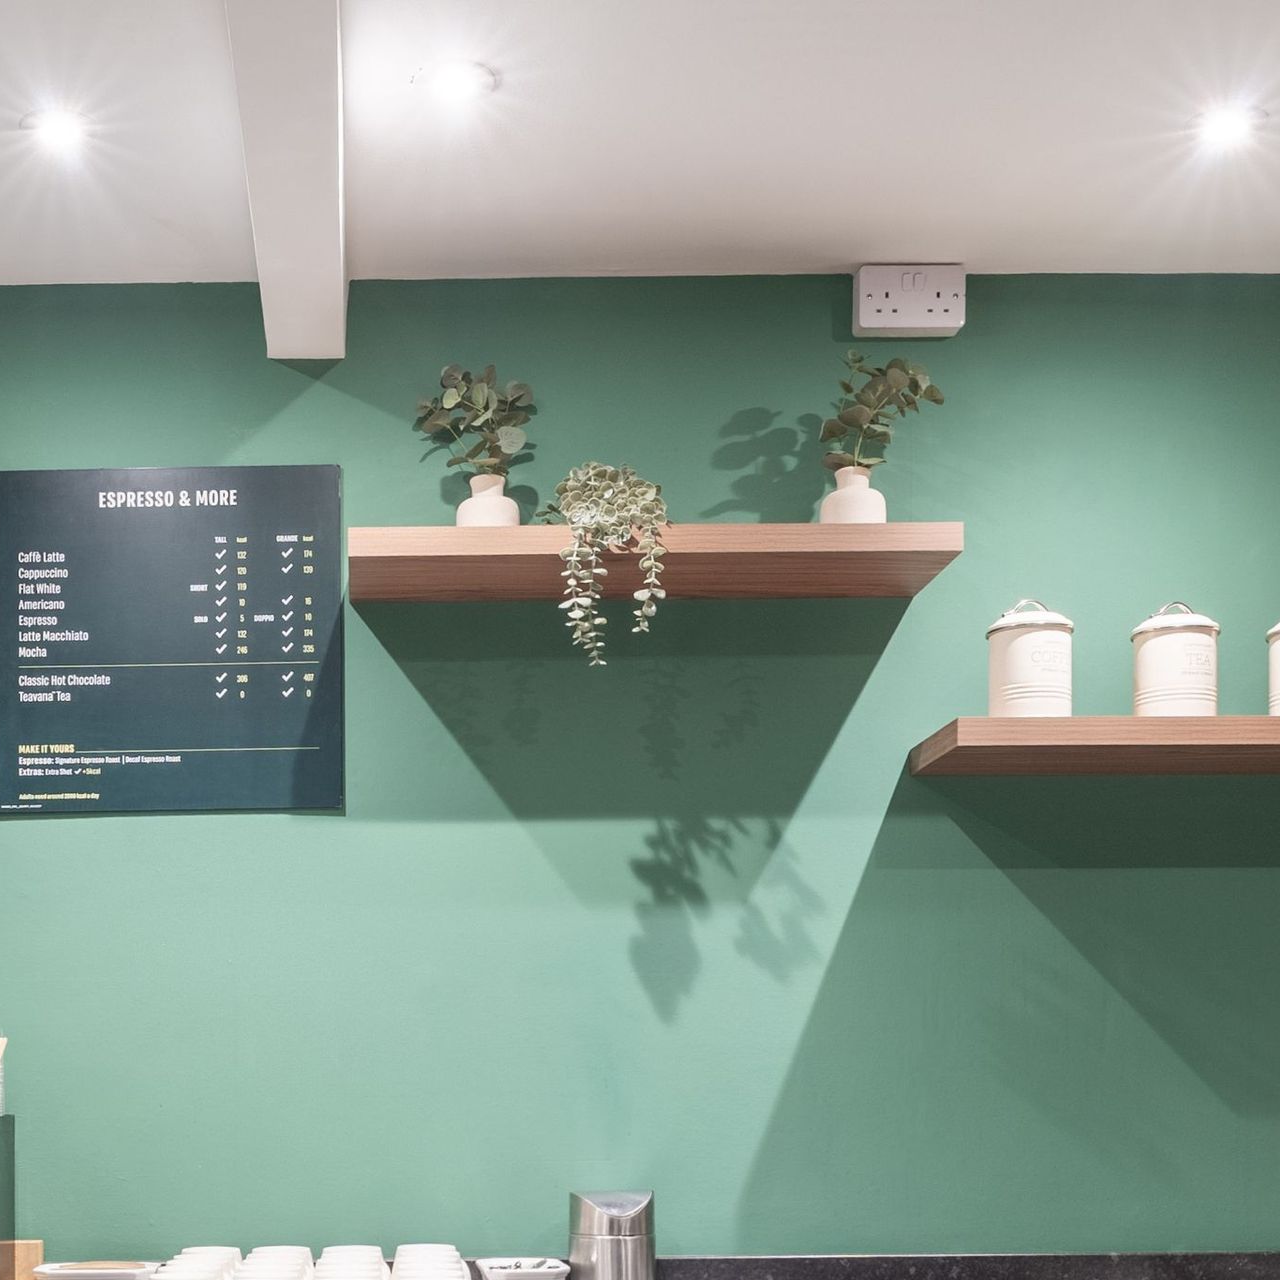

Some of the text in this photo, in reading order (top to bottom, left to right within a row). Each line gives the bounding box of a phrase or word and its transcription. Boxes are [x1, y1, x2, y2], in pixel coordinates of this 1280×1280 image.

[98, 489, 238, 508] ESPRESSO & MORE
[18, 551, 41, 563] Caffè
[43, 551, 65, 563] Latte
[18, 567, 69, 581] Cappuccino
[18, 583, 35, 594] Flat
[36, 583, 61, 594] White
[18, 599, 65, 610] Americano
[18, 615, 57, 627] Espresso
[18, 631, 41, 642] Latte
[43, 630, 89, 641] Macchiato
[18, 646, 48, 657] Mocha
[18, 675, 50, 686] Classic
[51, 675, 66, 686] Hot
[67, 674, 111, 686] Chocolate
[56, 690, 71, 701] Tea
[19, 744, 75, 753] MAKE IT YOURS
[18, 757, 54, 766] Espresso:
[18, 768, 44, 776] Extras:
